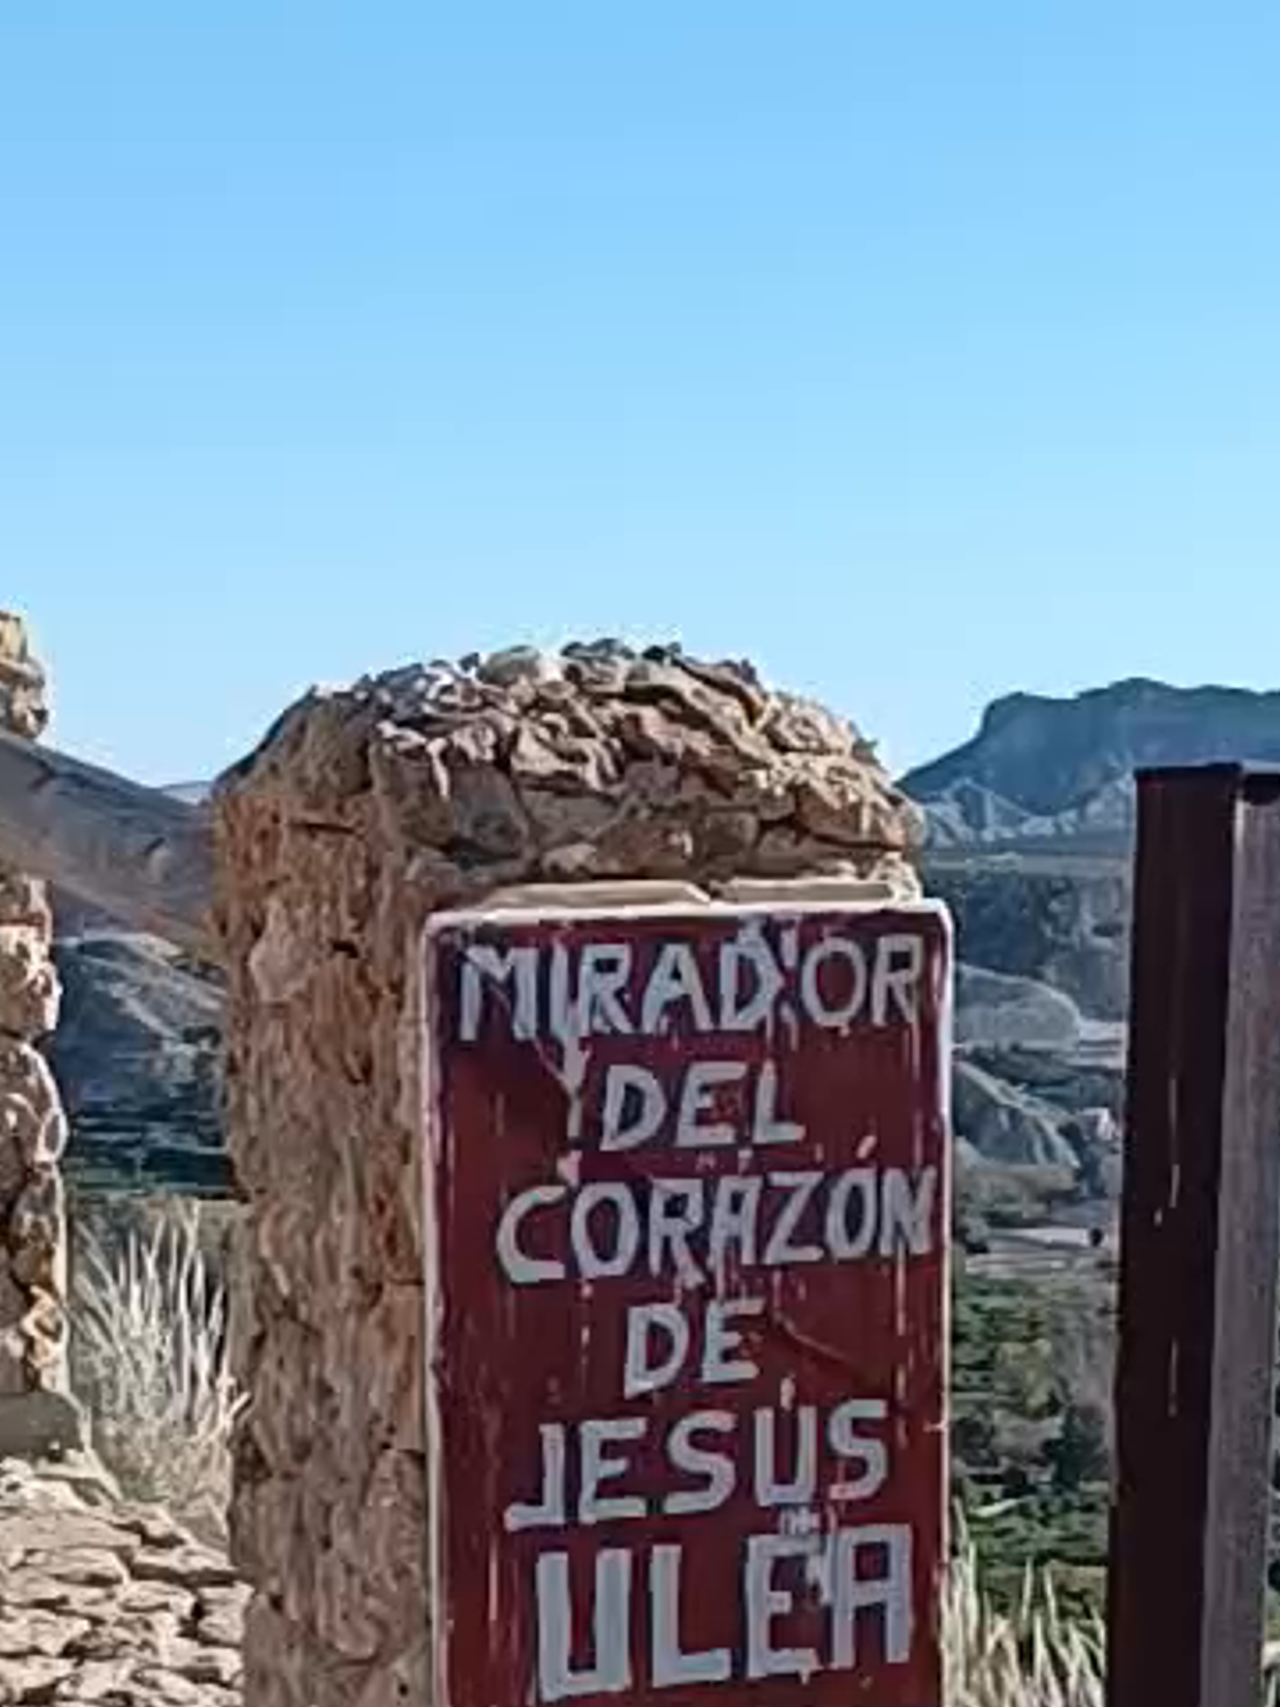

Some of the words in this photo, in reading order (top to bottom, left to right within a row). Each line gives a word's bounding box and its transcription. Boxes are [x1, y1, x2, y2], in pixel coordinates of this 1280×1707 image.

[458, 933, 924, 1041] MIRADOR
[599, 1060, 805, 1151] DEL
[622, 1297, 765, 1398] DE
[535, 1523, 914, 1701] ULEA
